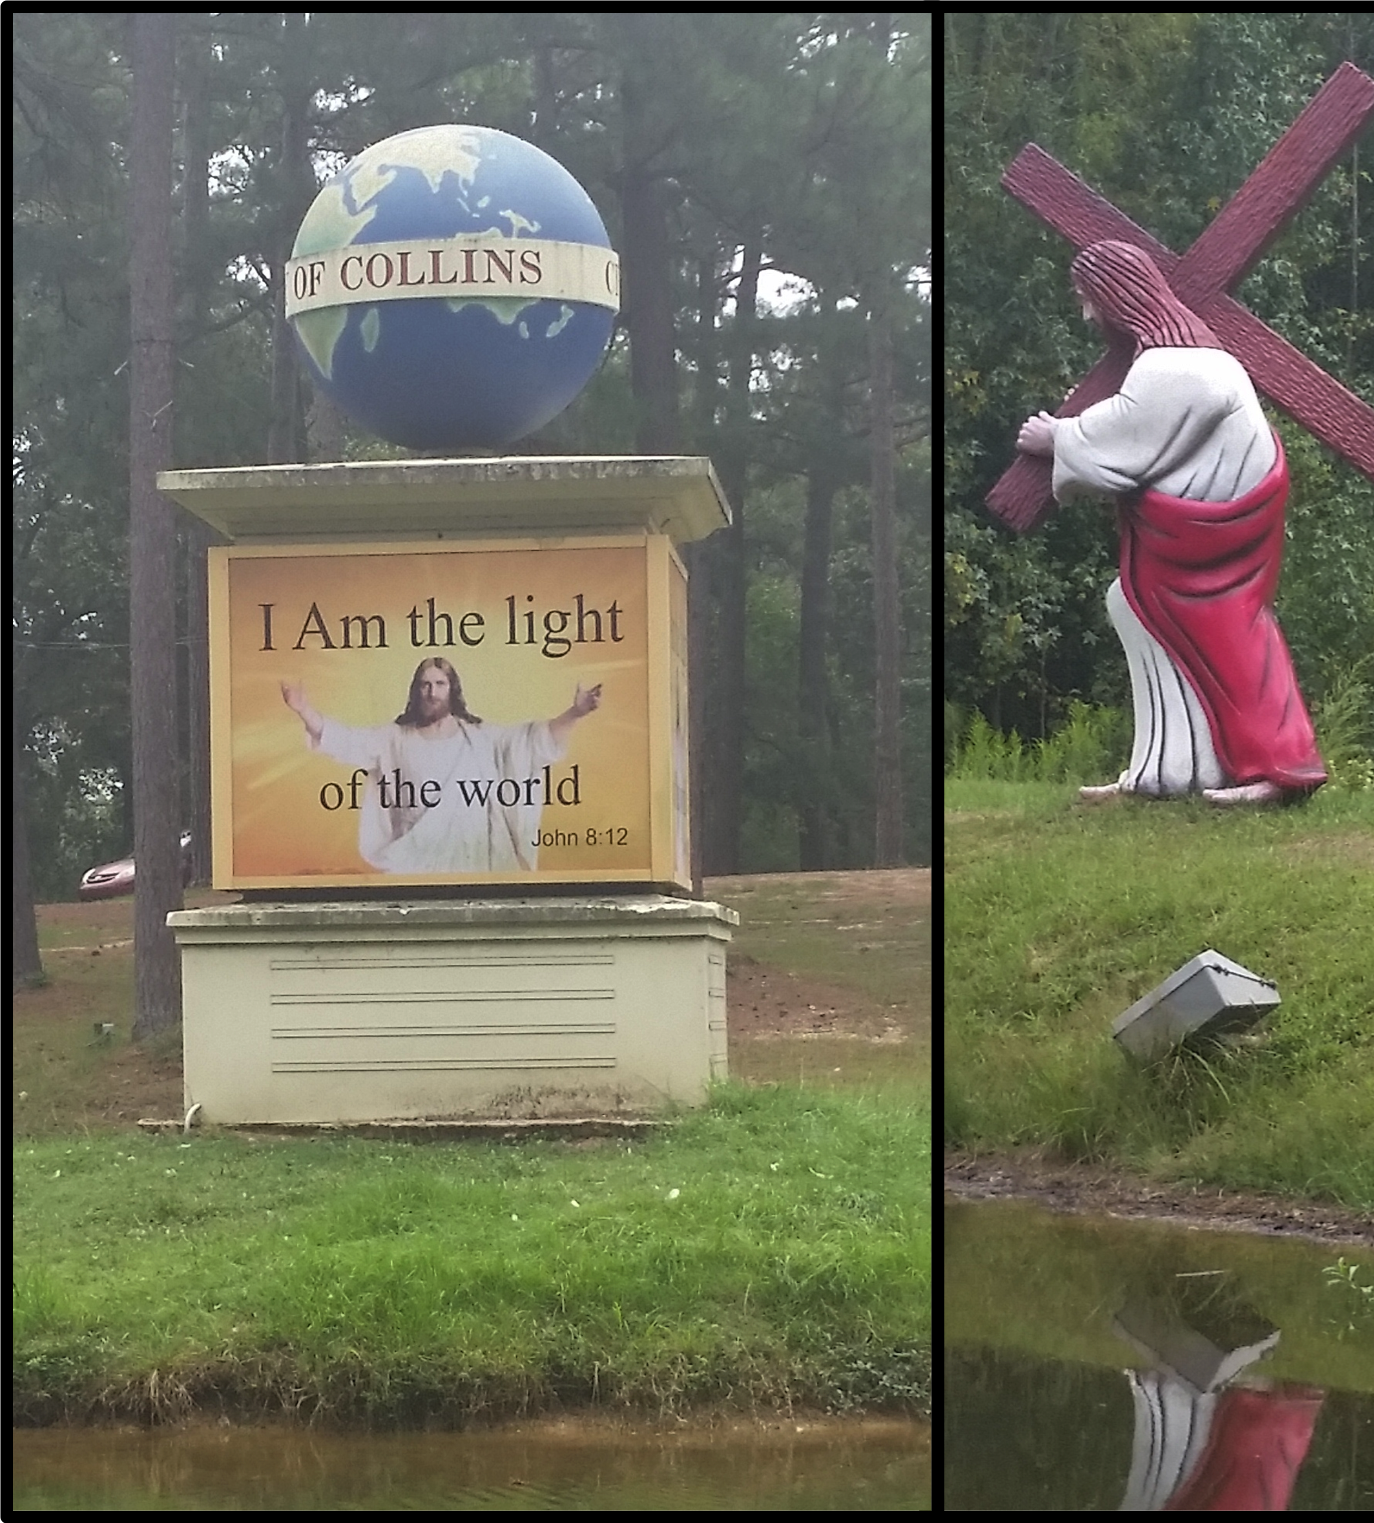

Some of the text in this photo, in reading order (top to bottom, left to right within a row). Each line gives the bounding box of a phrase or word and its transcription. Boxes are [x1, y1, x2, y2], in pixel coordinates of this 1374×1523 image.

[293, 249, 543, 300] OF COLLINS
[258, 593, 625, 658] I Am the light
[319, 764, 582, 811] of the world
[531, 827, 629, 847] John 8:12
